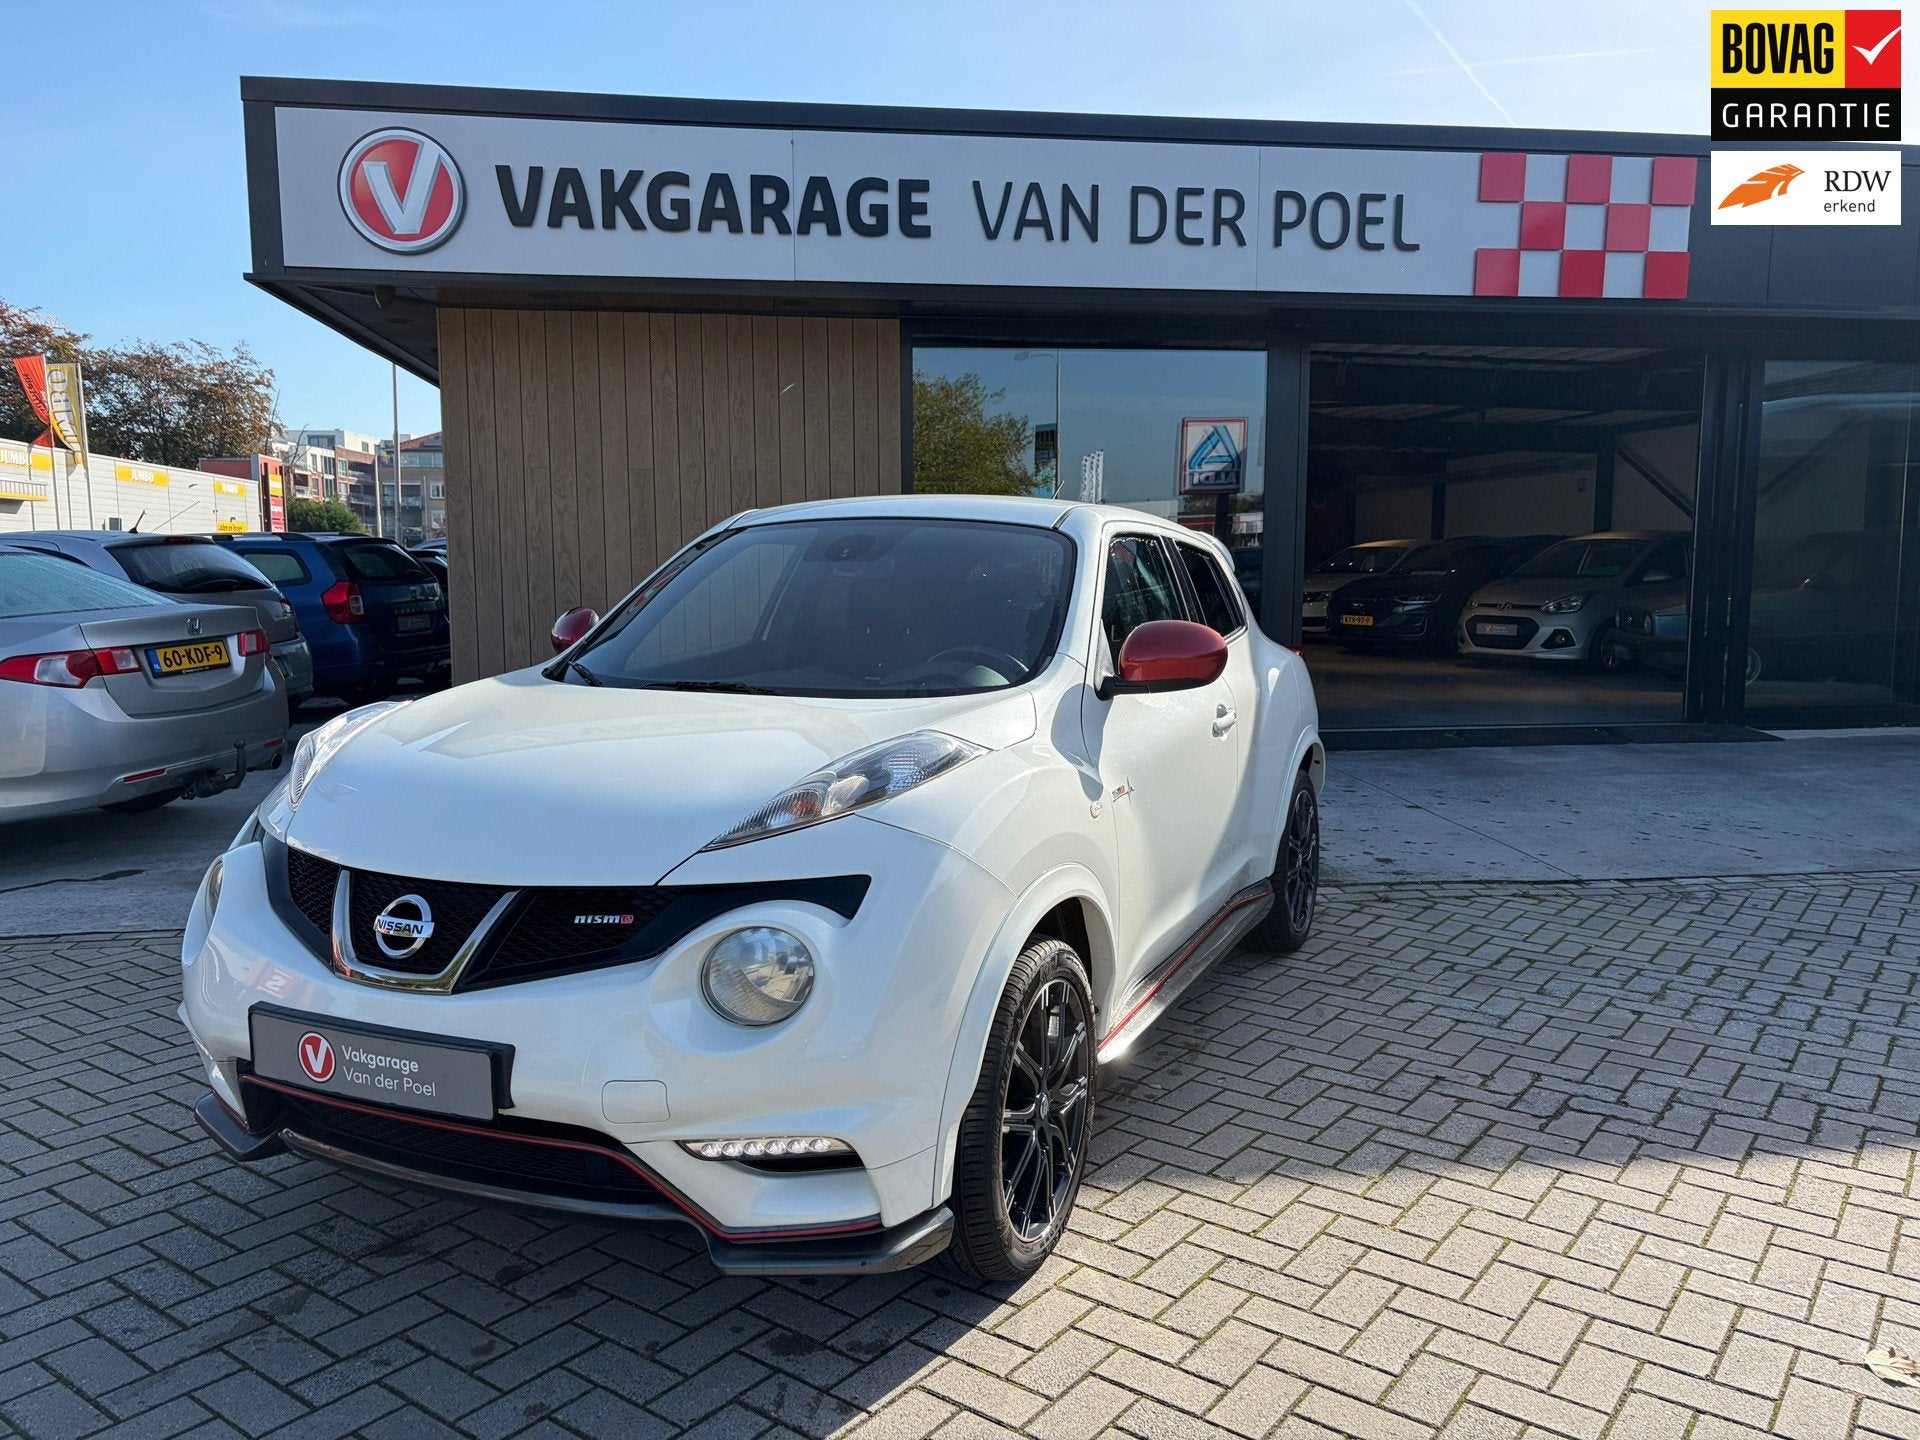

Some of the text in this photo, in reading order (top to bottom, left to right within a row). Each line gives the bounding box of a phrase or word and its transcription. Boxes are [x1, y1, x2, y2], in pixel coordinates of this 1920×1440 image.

[495, 163, 1420, 252] VAKGARAGE VAN DER POEL
[0, 450, 33, 468] JUMBO
[131, 468, 154, 483] JUMBO
[221, 482, 239, 495] JUMBO
[163, 644, 222, 668] 60-KDF-9
[377, 918, 424, 935] NISSAN
[342, 1045, 419, 1075] Vakgarage
[343, 1066, 436, 1097] Van der Poel
